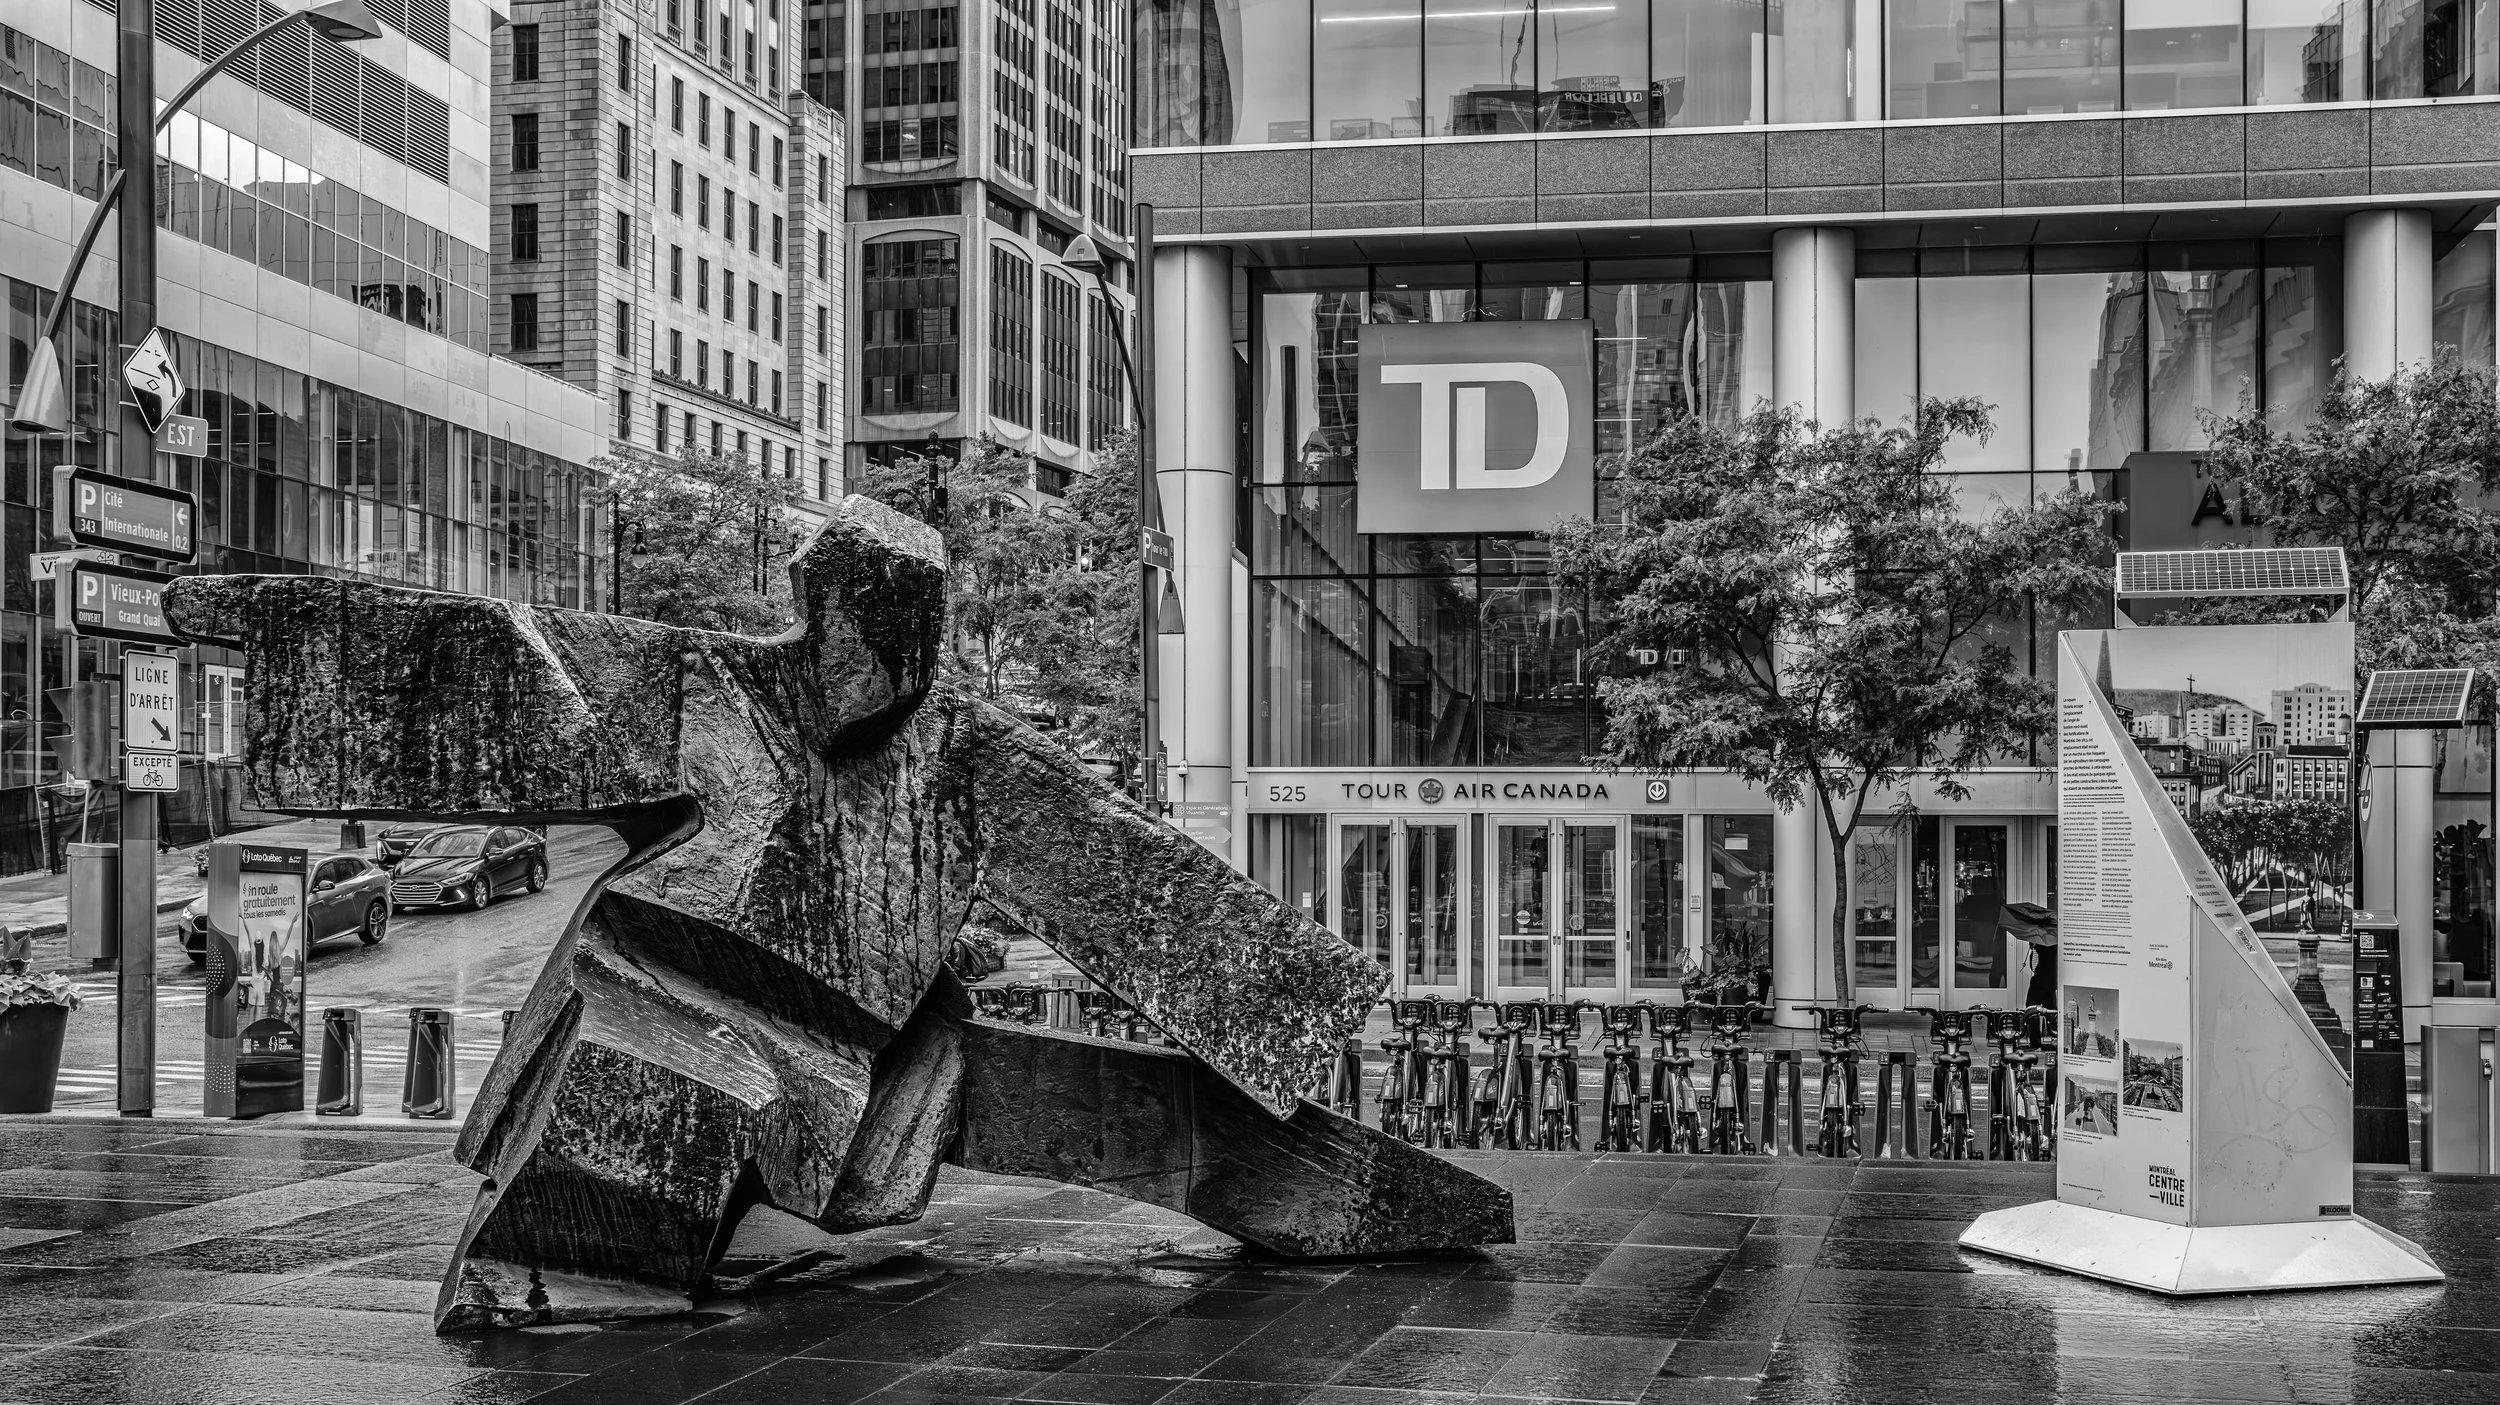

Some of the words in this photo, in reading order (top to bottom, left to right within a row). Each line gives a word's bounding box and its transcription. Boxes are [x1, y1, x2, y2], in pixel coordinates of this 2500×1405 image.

[167, 422, 195, 447] EST
[1381, 362, 1569, 489] TD
[80, 483, 97, 514] P
[105, 490, 123, 508] Cité
[80, 518, 96, 534] 343
[104, 516, 169, 542] Internationale
[82, 575, 98, 605] P
[111, 583, 161, 607] Vieux-Po
[78, 611, 101, 624] OUVERT
[118, 609, 141, 625] Grand
[143, 613, 161, 627] Quai
[1636, 649, 1659, 665] TD
[135, 666, 169, 685] LIGNE
[130, 692, 174, 711] D'ARRÊT
[133, 755, 172, 768] EXCEPTÉ
[1269, 785, 1306, 802] 525
[1341, 783, 1408, 799] TOUR
[1453, 783, 1497, 799] AIR
[1503, 783, 1610, 799] CANADA
[251, 852, 262, 862] Loto
[258, 883, 278, 896] roule
[243, 894, 296, 912] gratuitement
[243, 911, 256, 920] tous
[265, 908, 286, 918] samedis
[2149, 1164, 2176, 1176] MONTRÉAL
[2149, 1174, 2184, 1192] CENTRE
